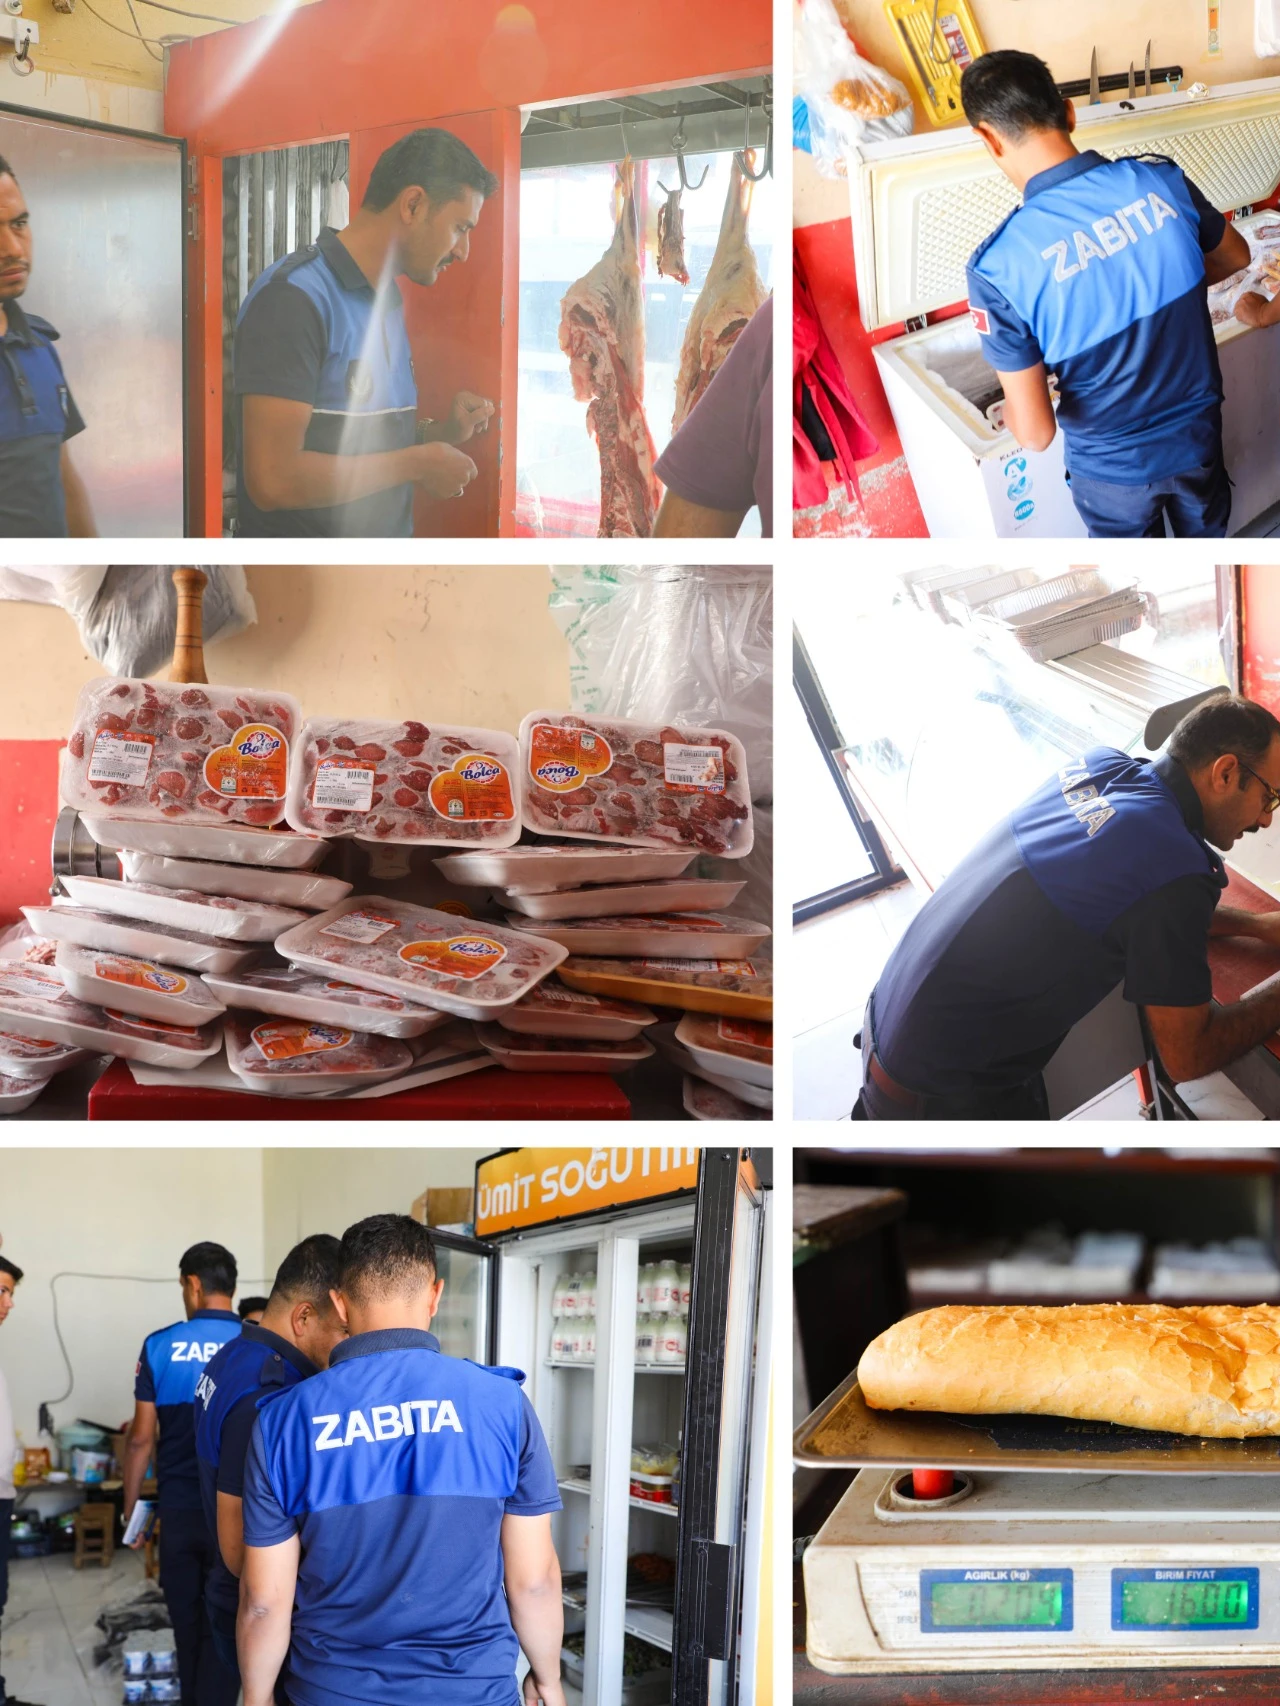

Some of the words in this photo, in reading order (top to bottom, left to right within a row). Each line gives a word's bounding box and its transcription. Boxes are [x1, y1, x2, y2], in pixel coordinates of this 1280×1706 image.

[1040, 191, 1179, 283] ZABITA
[460, 761, 500, 780] Bolca
[449, 942, 499, 955] Bolca
[171, 1341, 224, 1362] ZAB
[312, 1400, 463, 1451] ZABITA
